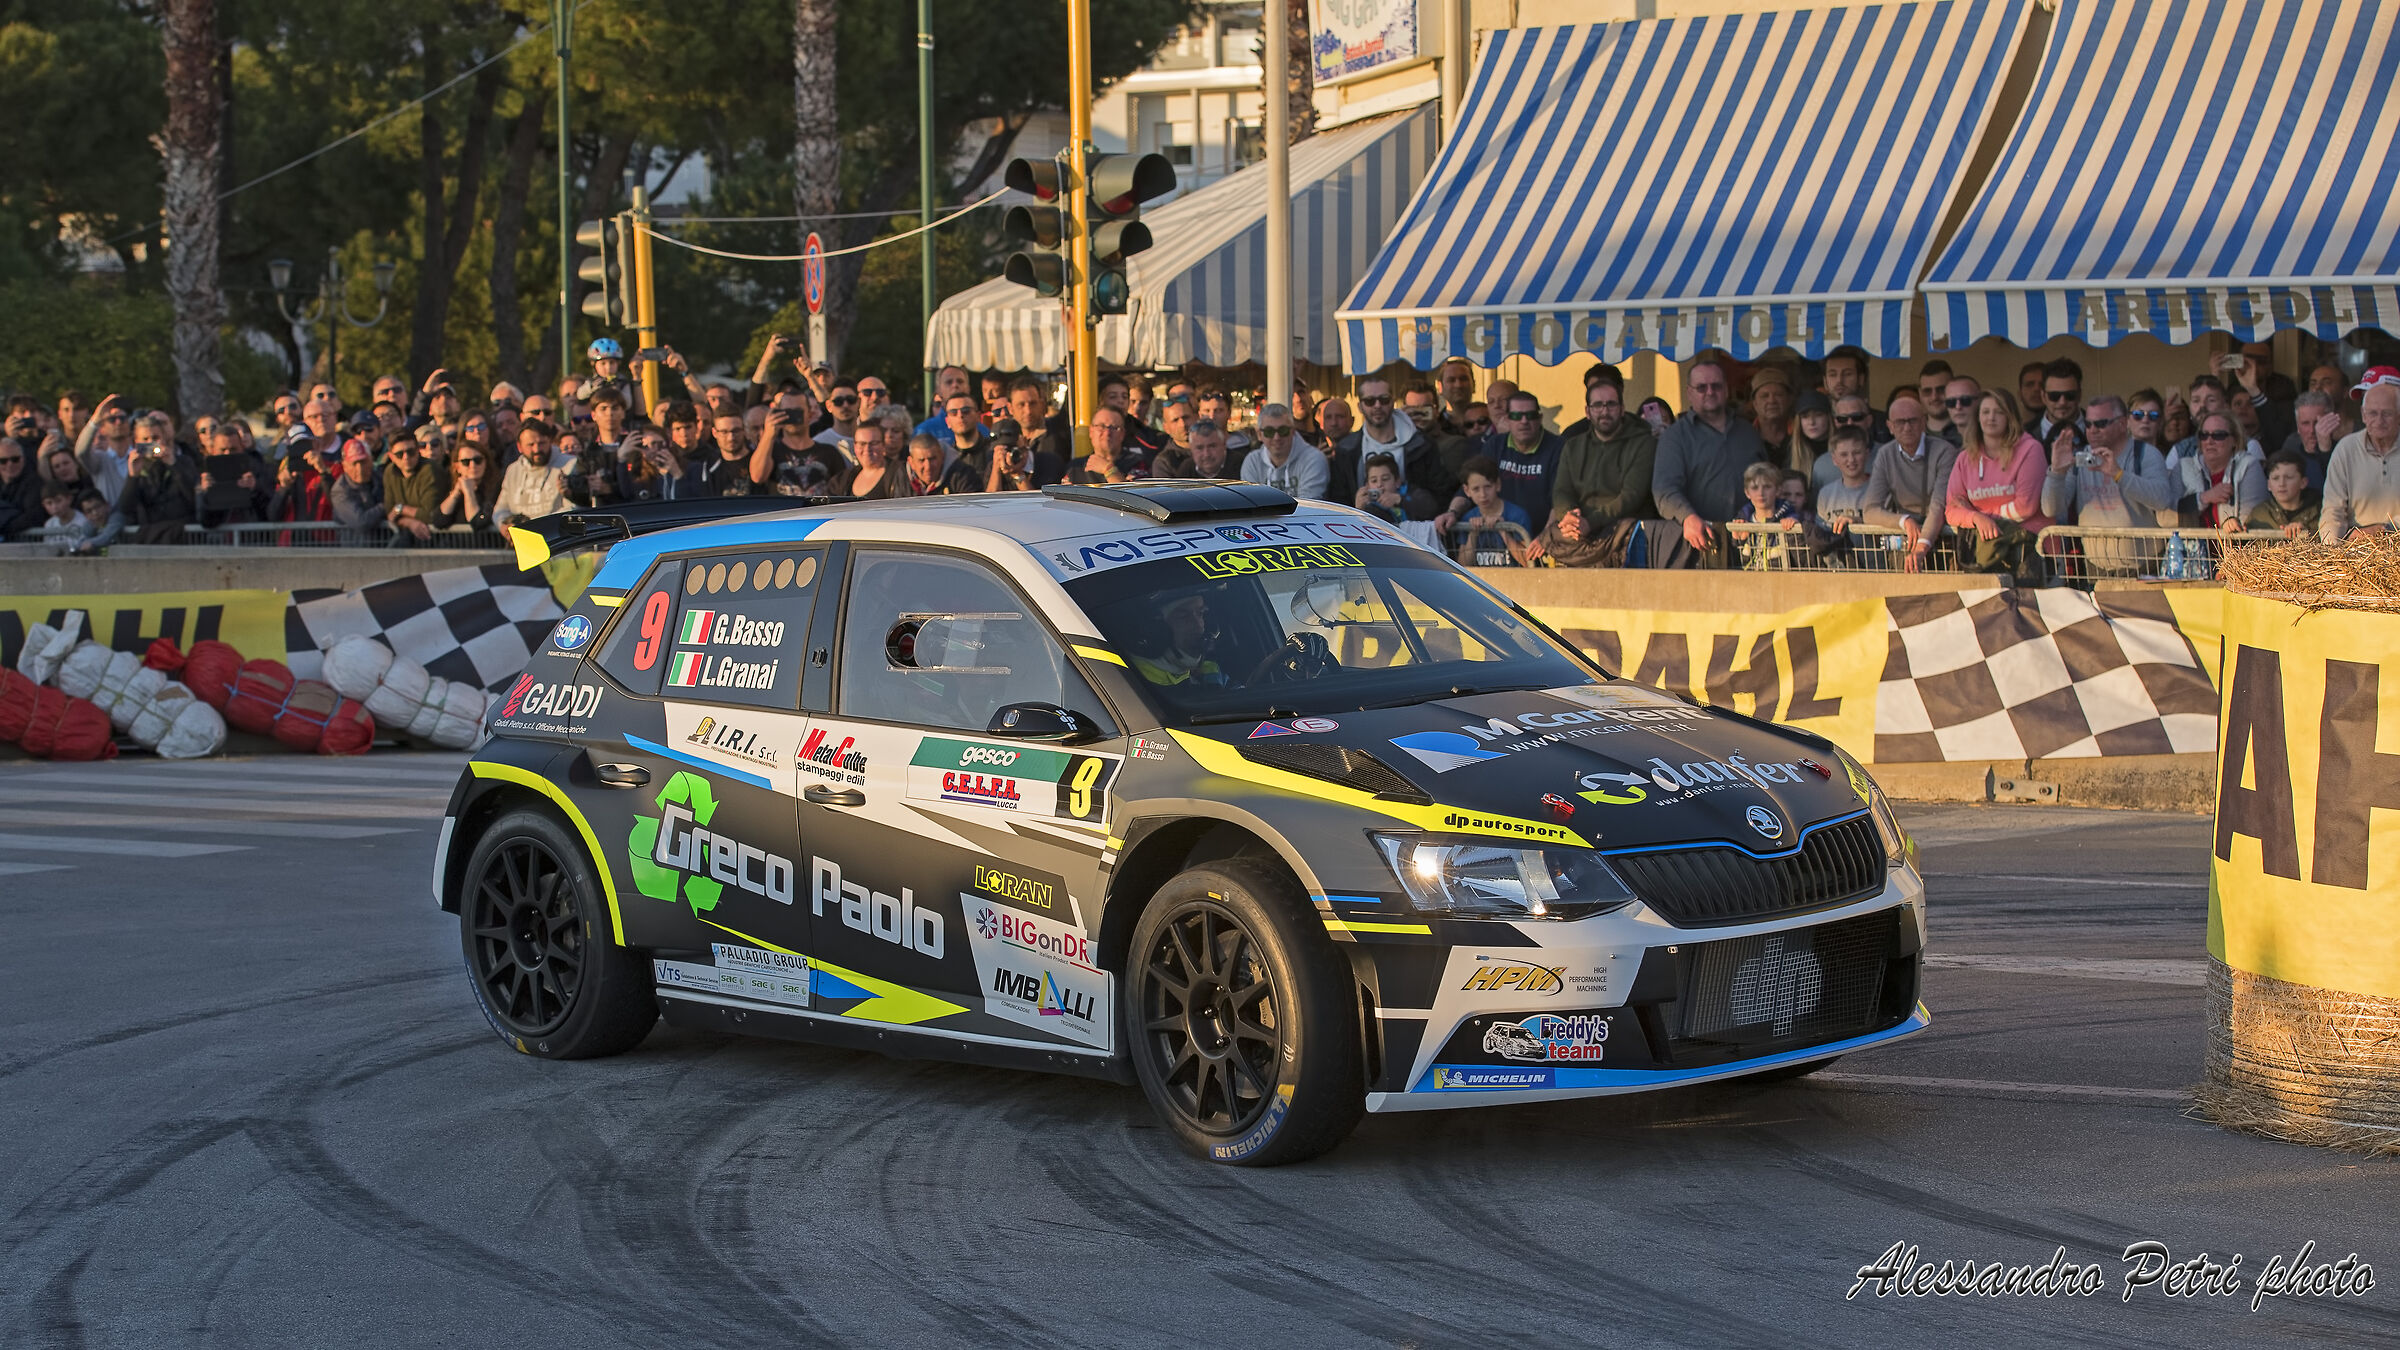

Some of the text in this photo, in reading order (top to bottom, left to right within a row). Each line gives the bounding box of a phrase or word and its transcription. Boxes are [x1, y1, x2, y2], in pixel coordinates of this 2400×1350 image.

[2073, 290, 2379, 332] ARTICOLI
[1463, 306, 1843, 352] GIOCATTOLI
[1078, 540, 1143, 570] ACI
[1138, 523, 1325, 555] SPORT
[1185, 544, 1366, 580] LORAN
[556, 624, 589, 642] Sang-A
[633, 591, 670, 671] 9
[713, 613, 785, 647] G.Basso
[700, 655, 779, 690] L.Granai
[521, 682, 604, 719] GADDI
[494, 719, 508, 727] Gaddi
[1462, 707, 1714, 741] M.CarRent
[1505, 722, 1697, 753] www.mcarrnt.it
[797, 761, 866, 786] stampaggi edili
[942, 771, 1021, 801] C.E.L.F.A.
[1069, 757, 1103, 818] 9
[1646, 755, 1802, 793] danfer
[996, 801, 1018, 810] LUCCA
[1444, 813, 1567, 839] dp autosport
[655, 803, 945, 960] Greco Paolo
[974, 864, 1053, 909] LORAN
[658, 961, 681, 981] VTS
[720, 945, 771, 965] PALLADIO
[774, 954, 809, 971] GROUP
[1593, 966, 1607, 974] HIGH
[720, 974, 738, 984] sac
[751, 979, 768, 989] sac
[782, 984, 800, 993] sac
[1461, 966, 1567, 991] HPM
[993, 967, 1095, 1021] IMBALLI
[1539, 1015, 1608, 1045] Freddy's
[1549, 1043, 1601, 1059] team
[1467, 1074, 1546, 1083] MICHELIN
[1215, 1117, 1278, 1158] MICHELIN
